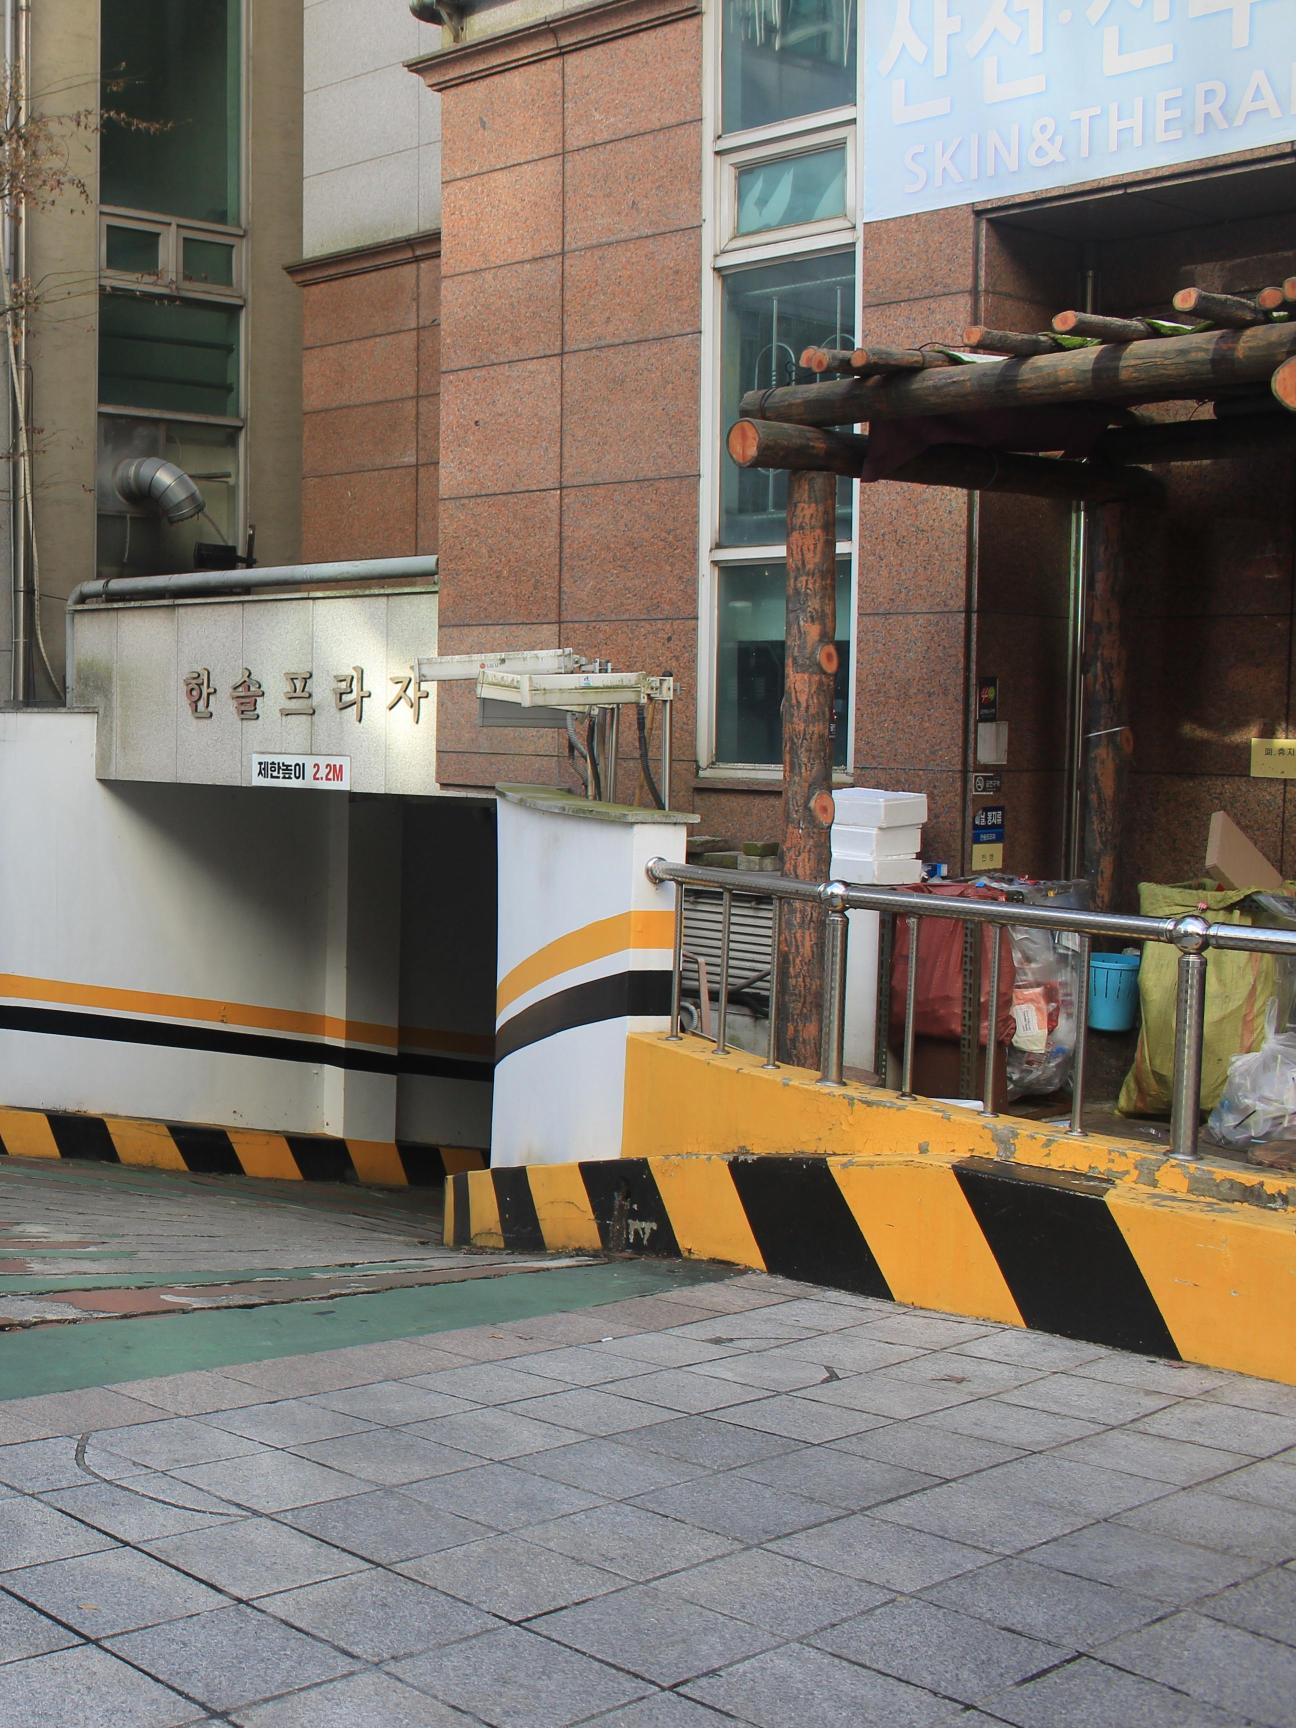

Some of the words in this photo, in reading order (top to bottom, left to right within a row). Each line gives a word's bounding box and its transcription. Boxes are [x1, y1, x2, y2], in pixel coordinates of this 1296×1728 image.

[903, 60, 1296, 195] SKIN&THERA
[183, 666, 429, 724] 한솔프라자
[257, 760, 306, 781] 제한높이
[312, 763, 344, 782] 2.2M
